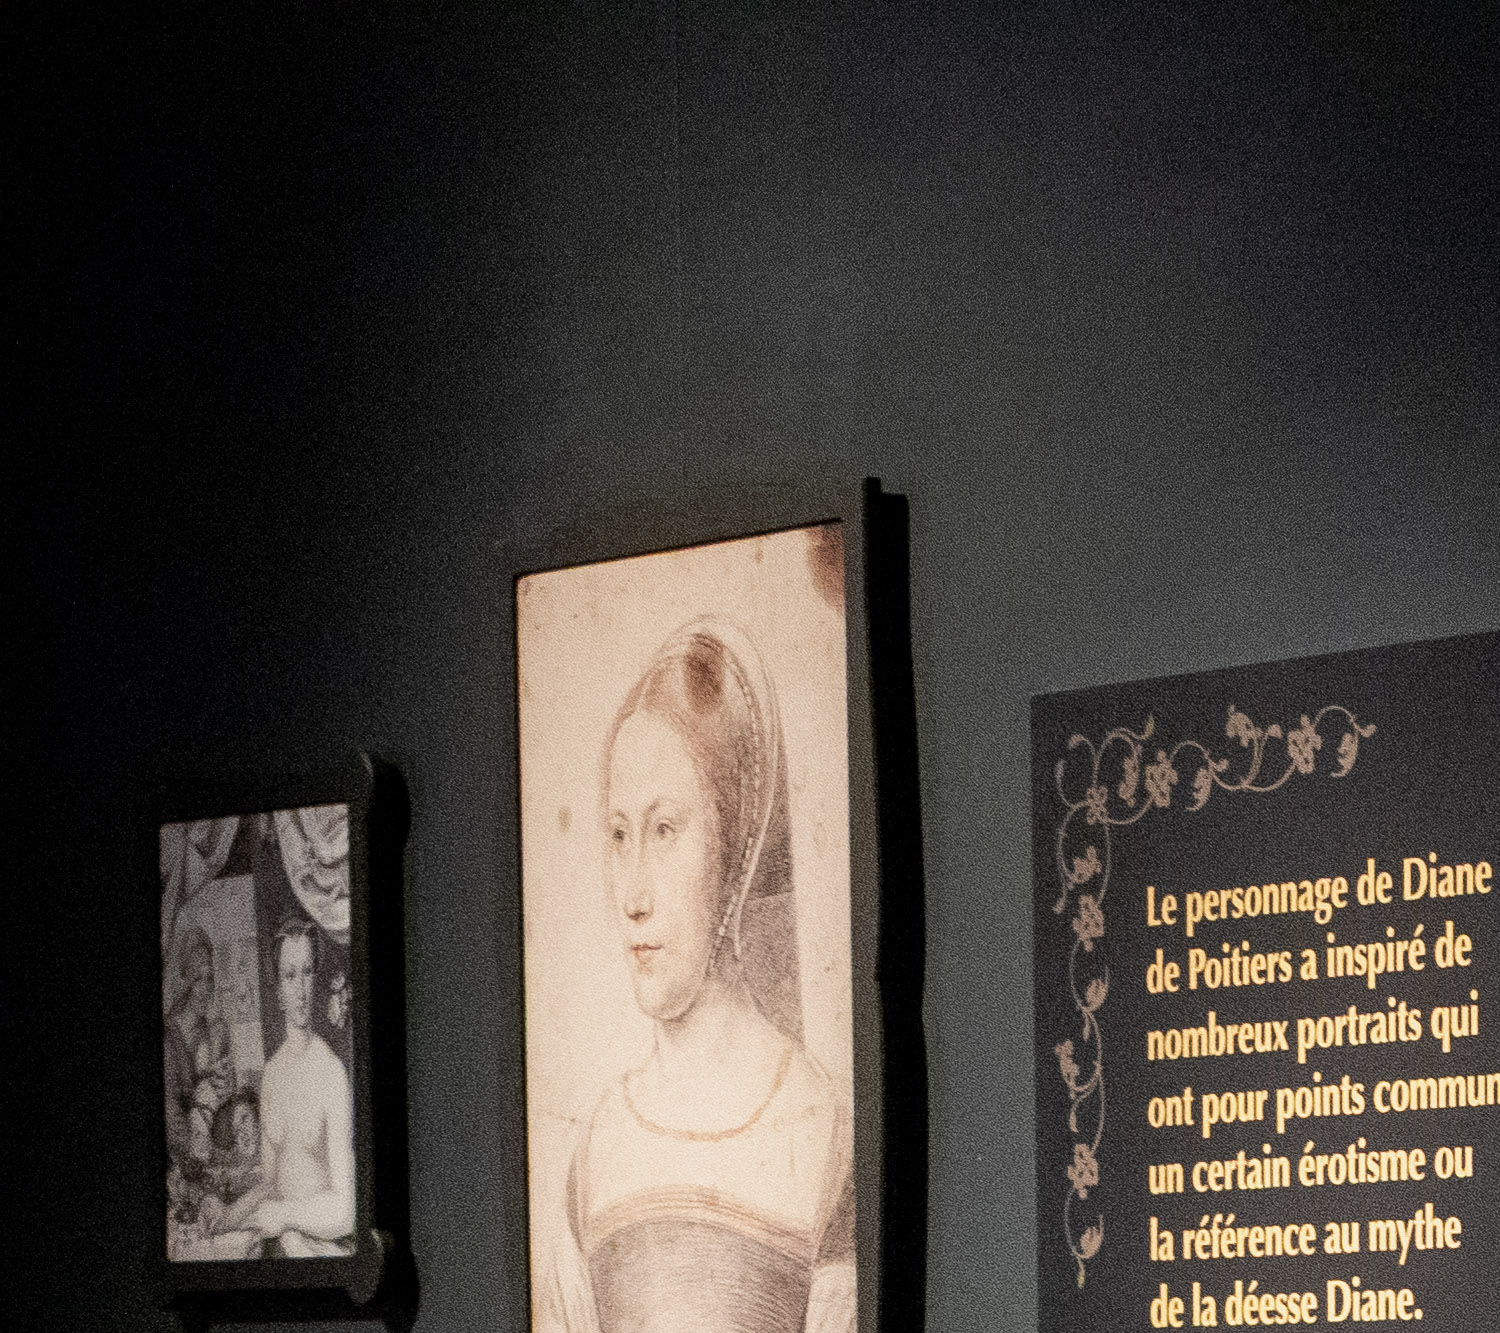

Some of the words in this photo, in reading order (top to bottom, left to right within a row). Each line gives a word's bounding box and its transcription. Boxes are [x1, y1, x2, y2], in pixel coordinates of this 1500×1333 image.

[1148, 887, 1176, 925] Le
[1187, 877, 1348, 936] personnage
[1357, 859, 1392, 905] de
[1404, 853, 1491, 900] Diane
[1147, 949, 1179, 993] de
[1190, 941, 1292, 989] Poitiers
[1301, 949, 1317, 980] a
[1327, 925, 1425, 988] inspiré
[1435, 921, 1471, 968] de
[1148, 1012, 1288, 1060] nombreux
[1298, 997, 1422, 1063] portraits
[1431, 990, 1478, 1052] qui
[1148, 1088, 1193, 1127] ont
[1203, 1091, 1268, 1138] pour
[1277, 1072, 1365, 1133] points
[1150, 1164, 1183, 1194] un
[1193, 1144, 1290, 1192] certain
[1299, 1138, 1426, 1186] érotisme
[1435, 1147, 1472, 1178] ou
[1151, 1217, 1174, 1260] la
[1183, 1214, 1316, 1259] référence
[1324, 1223, 1359, 1253] au
[1369, 1203, 1461, 1265] mythe
[1151, 1284, 1184, 1327] de
[1193, 1282, 1217, 1326] la
[1225, 1281, 1317, 1325] déesse
[1327, 1277, 1422, 1322] Diane.
